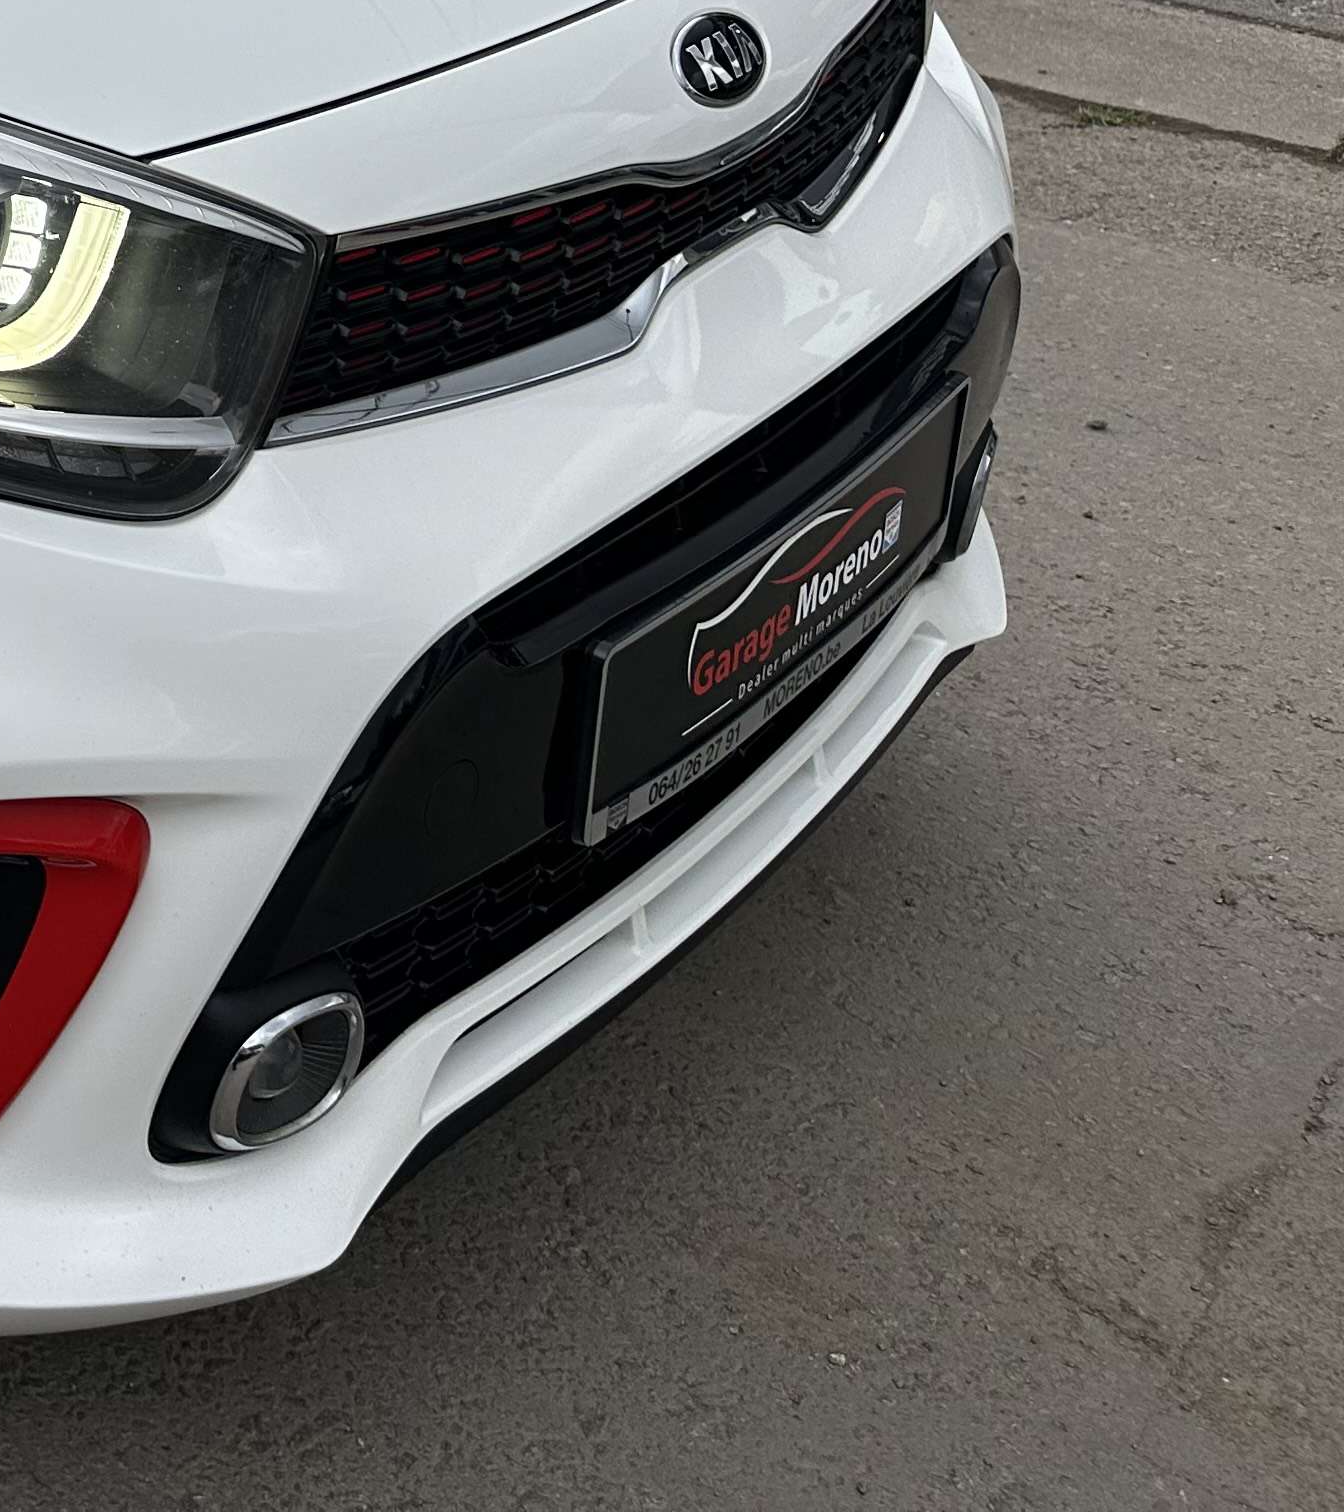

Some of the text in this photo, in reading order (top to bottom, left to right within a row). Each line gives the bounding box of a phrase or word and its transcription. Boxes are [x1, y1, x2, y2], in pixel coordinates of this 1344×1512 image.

[685, 23, 762, 91] KIA
[693, 529, 883, 696] Garage Moreno
[738, 589, 864, 701] Dealer multi marques
[648, 753, 702, 806] 064/26
[704, 738, 724, 768] 27
[725, 721, 742, 752] 91
[762, 641, 842, 719] MORENO.be
